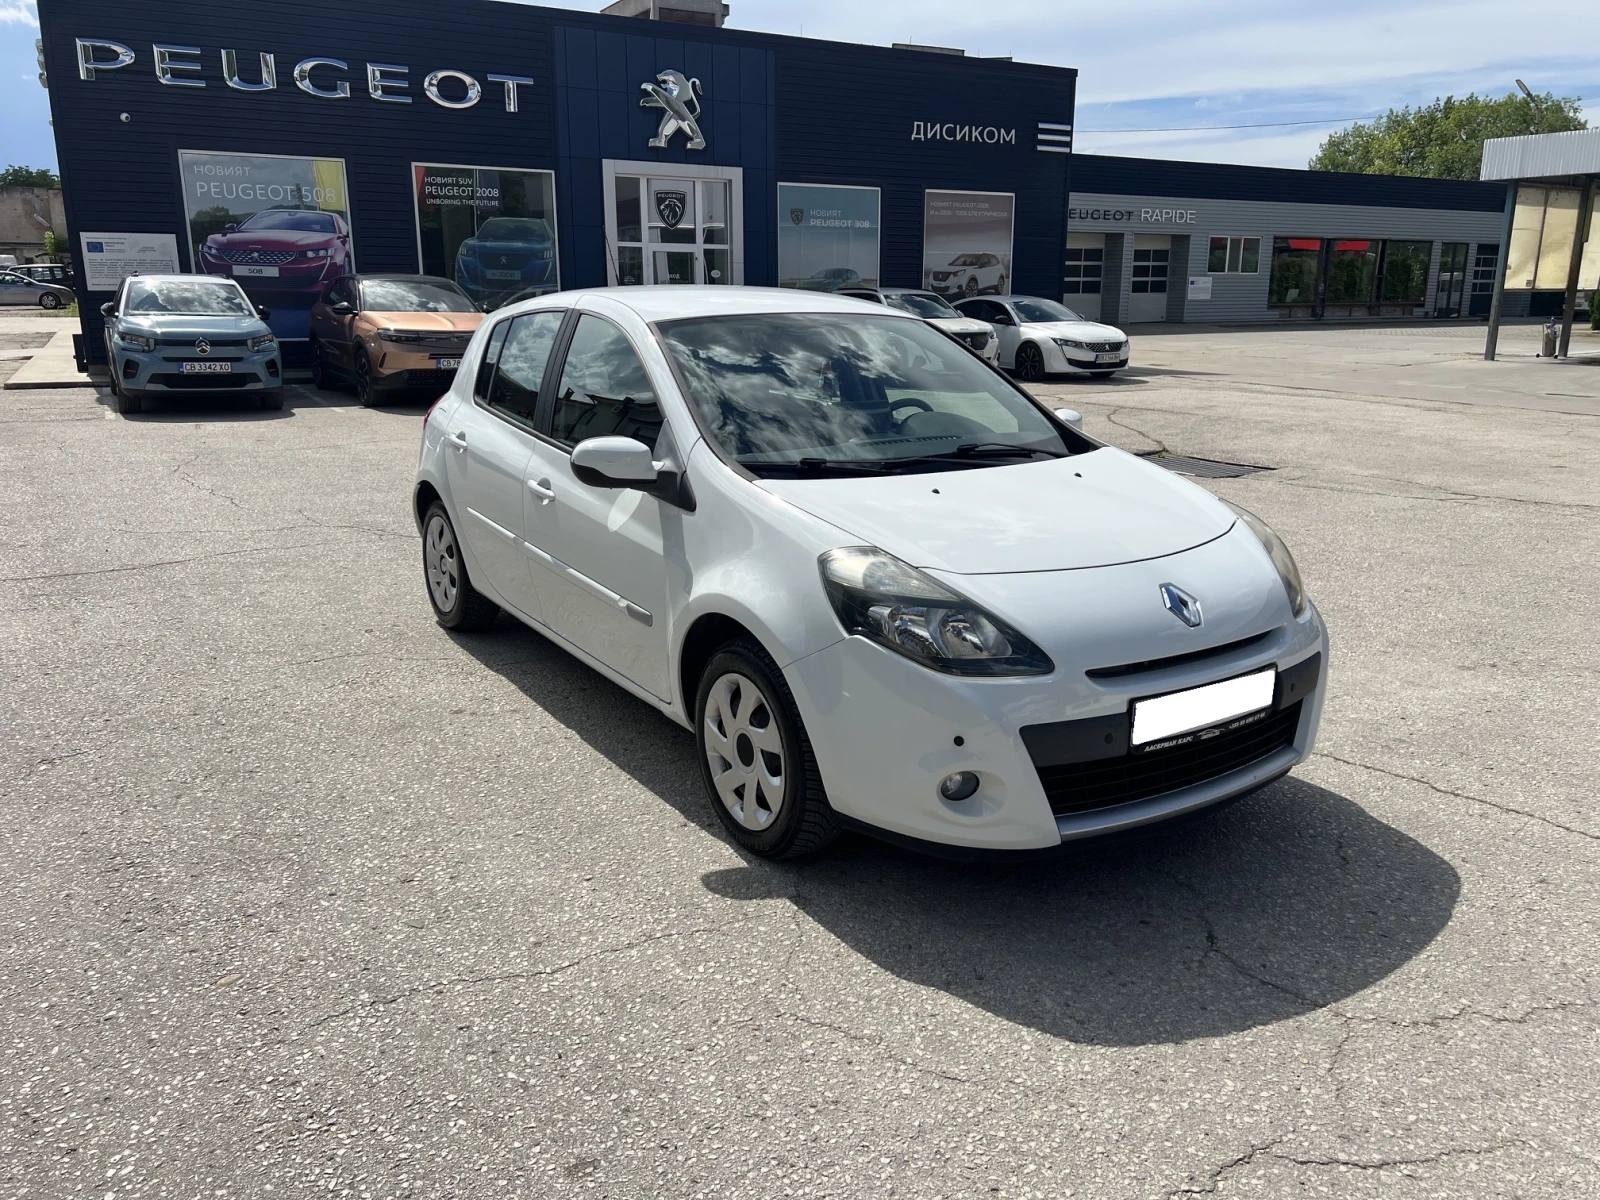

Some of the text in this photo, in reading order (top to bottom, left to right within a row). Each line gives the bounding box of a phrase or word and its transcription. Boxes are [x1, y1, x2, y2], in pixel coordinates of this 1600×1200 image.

[75, 37, 534, 113] PEUGEOT
[911, 121, 1016, 145] ДИСИКОМ
[193, 164, 251, 177] НОВИЯТ
[424, 176, 473, 185] НОВИЯТ SUV
[196, 181, 336, 203] PEUGEOT 508
[425, 186, 499, 197] PEUGEOT 2008
[426, 198, 461, 206] UNBORING
[476, 199, 499, 207] FUTURE
[810, 209, 842, 217] НОВИЯТ
[1068, 208, 1197, 223] EUGEOT RAPIDE
[810, 218, 870, 228] PEUGEOT 308
[184, 363, 230, 371] CB 3342 XO
[442, 359, 451, 367] CB
